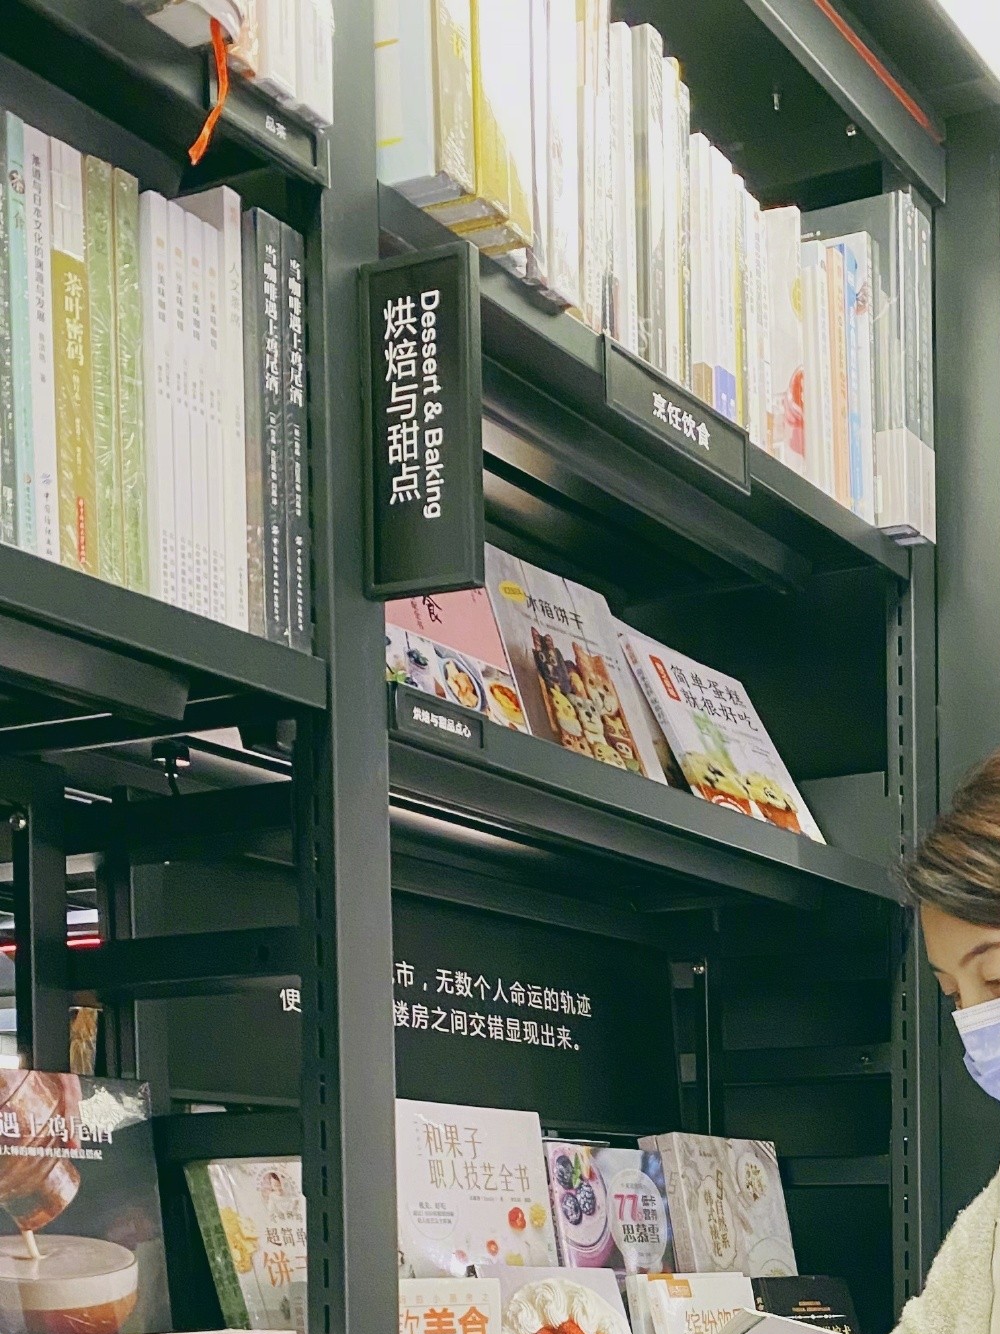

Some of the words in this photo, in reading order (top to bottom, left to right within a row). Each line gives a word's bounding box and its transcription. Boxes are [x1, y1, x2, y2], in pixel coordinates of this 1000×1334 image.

[264, 115, 287, 141] 品茶
[263, 244, 279, 395] 当咖啡遇上鸡尾酒
[288, 258, 303, 408] 当咖啡遇上鸡尾酒
[420, 290, 440, 395] Dessert
[383, 296, 421, 506] 烘焙与甜点
[423, 402, 440, 421] &
[651, 391, 711, 451] 烹饪饮食
[424, 427, 442, 519] Baking
[671, 664, 746, 708] 简单蛋糕
[680, 688, 758, 732] 就很好吃
[391, 960, 593, 1018] 市，无数个人命运的轨迹
[392, 1000, 581, 1052] 楼房之间交错显现出来。
[423, 1122, 482, 1160] 和果子
[428, 1158, 531, 1193] 职人技艺全书
[613, 1193, 640, 1222] 77
